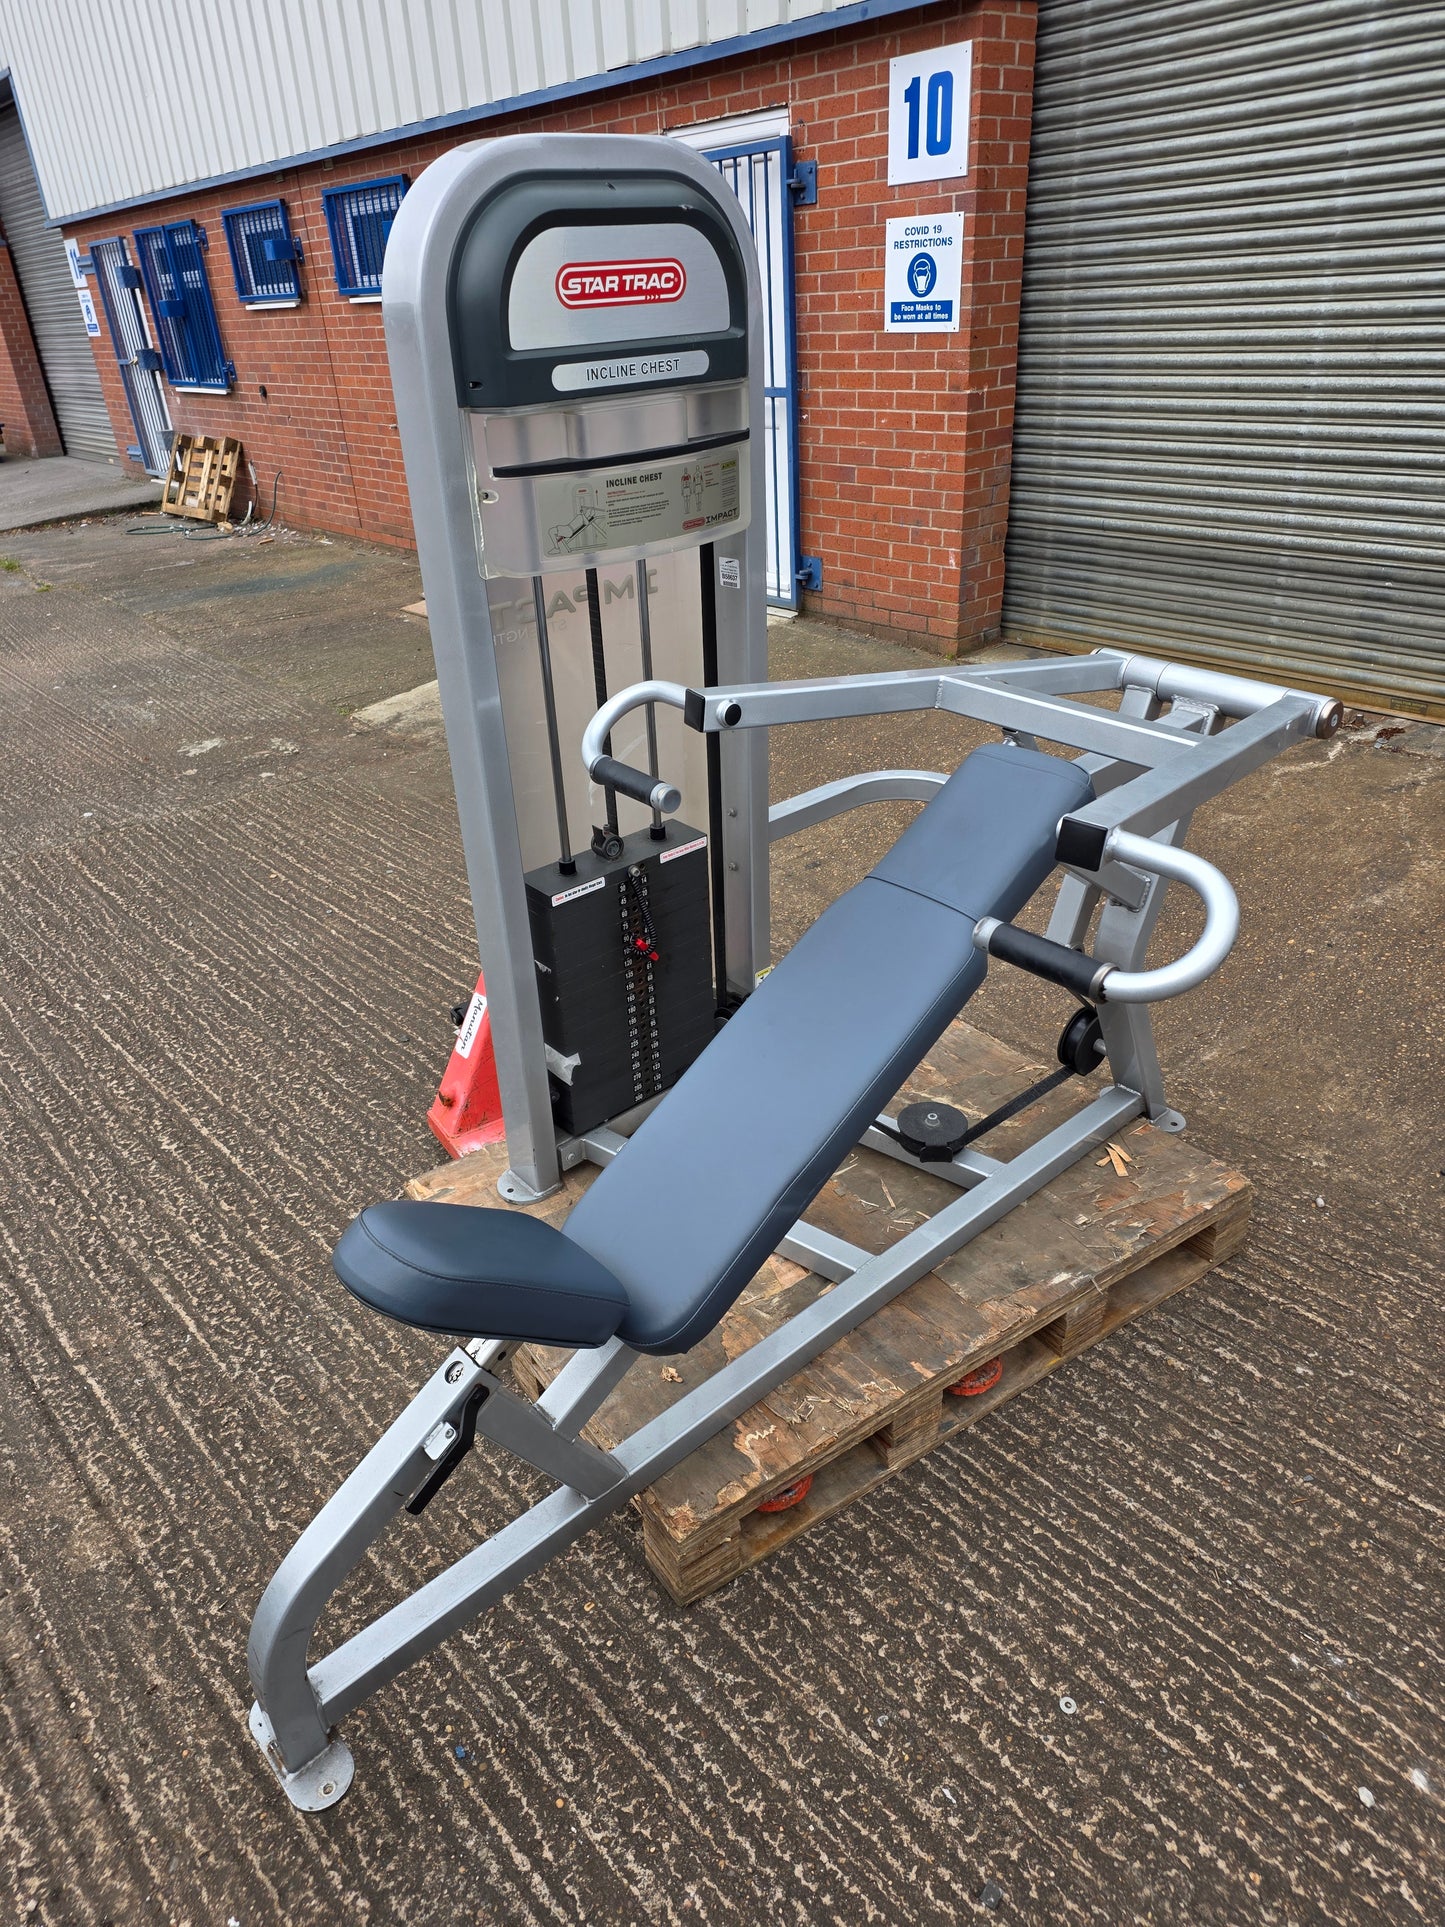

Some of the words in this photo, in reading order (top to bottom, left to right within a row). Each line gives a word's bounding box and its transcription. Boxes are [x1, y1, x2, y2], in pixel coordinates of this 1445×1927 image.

[904, 70, 953, 159] 10
[904, 226, 930, 236] COVID
[932, 225, 942, 234] 19
[894, 237, 953, 249] RESTRICTIONS
[564, 275, 619, 295] STAR
[622, 272, 675, 291] TRAC
[901, 304, 914, 312] Face
[924, 312, 932, 320] all
[933, 312, 949, 320] times
[586, 364, 636, 381] INCLINE
[641, 359, 680, 375] CHEST
[606, 476, 638, 488] INCLINE
[639, 472, 663, 483] CHEST
[705, 507, 738, 524] IMPACT
[624, 959, 632, 967] 120
[461, 998, 483, 1050] Manutan
